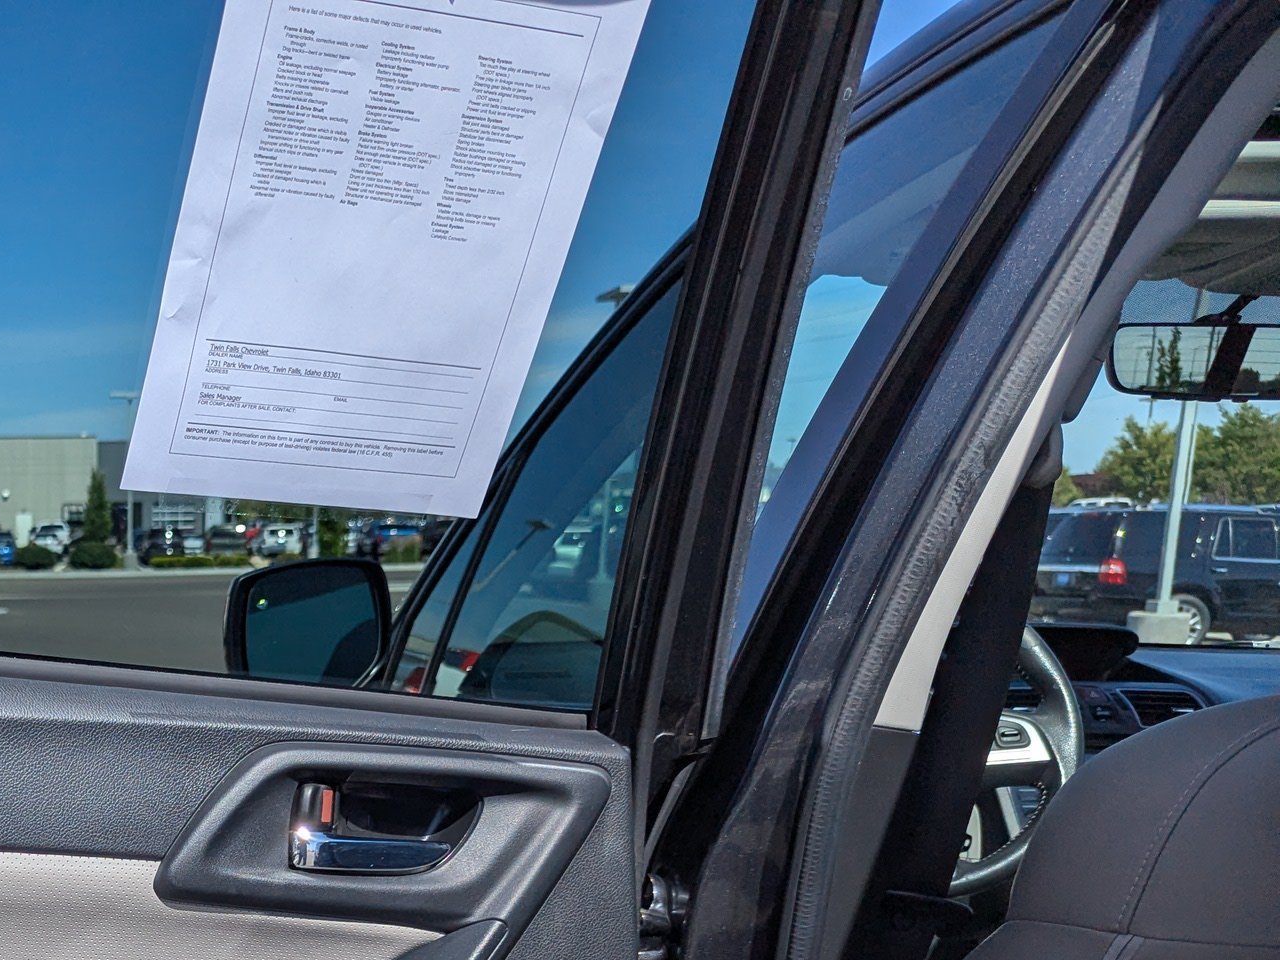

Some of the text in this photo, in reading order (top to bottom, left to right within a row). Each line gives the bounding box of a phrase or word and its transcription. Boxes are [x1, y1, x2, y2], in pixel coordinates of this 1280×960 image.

[210, 343, 269, 356] Twin Falls Chevrolet
[207, 359, 221, 367] 1731
[222, 361, 237, 369] Park
[237, 362, 252, 370] View
[252, 364, 271, 373] Drive,
[304, 369, 322, 377] Idaho
[322, 371, 341, 379] 83301
[199, 391, 242, 403] Sales Manager
